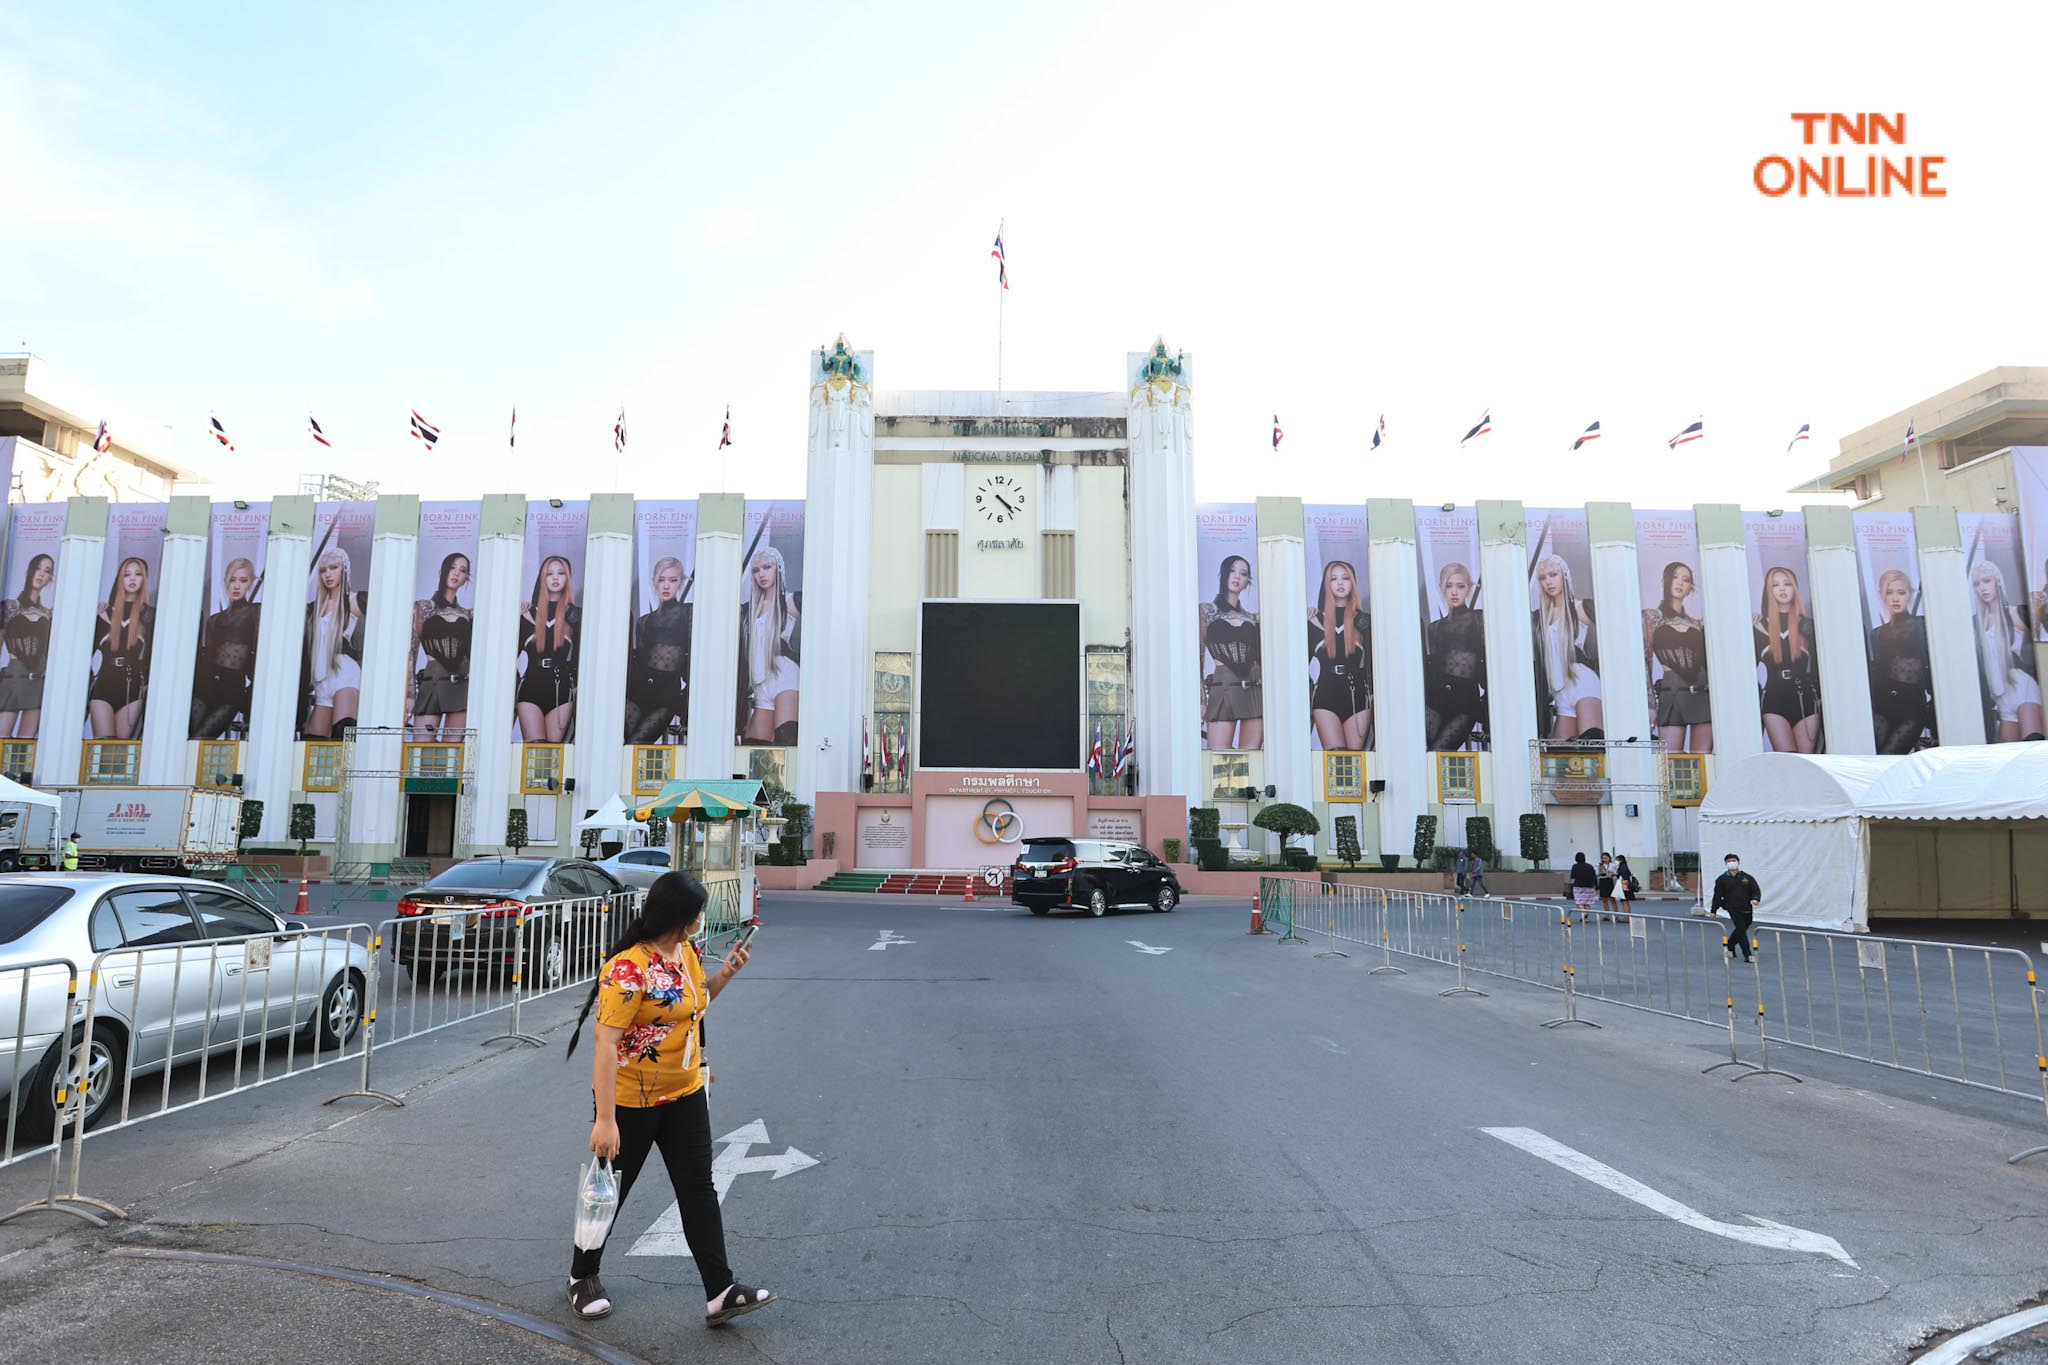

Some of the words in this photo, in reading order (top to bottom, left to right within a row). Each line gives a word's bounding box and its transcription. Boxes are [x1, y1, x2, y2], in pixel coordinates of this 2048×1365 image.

[952, 451, 1002, 462] NATIONAL
[1006, 451, 1048, 462] STADIUM
[995, 476, 1004, 484] 12
[976, 495, 982, 503] 9
[1018, 495, 1025, 503] 3
[111, 515, 138, 523] BORN
[142, 514, 165, 523] PINK
[213, 514, 240, 522] BORN
[244, 513, 268, 522] PINK
[423, 513, 451, 521] BORN
[455, 513, 478, 521] PINK
[530, 512, 558, 521] BORN
[562, 512, 586, 521] PINK
[638, 512, 666, 521] BORN
[671, 512, 695, 521] PINK
[748, 512, 777, 521] BORN
[781, 512, 806, 521] PINK
[997, 515, 1003, 523] 6
[1196, 514, 1225, 523] BORN
[1229, 514, 1253, 523] PINK
[1636, 521, 1664, 529] BORN
[1669, 521, 1693, 529] PINK
[977, 538, 1024, 552] ศุภชลาศัย
[962, 774, 1040, 787] กรมพลศึกษา
